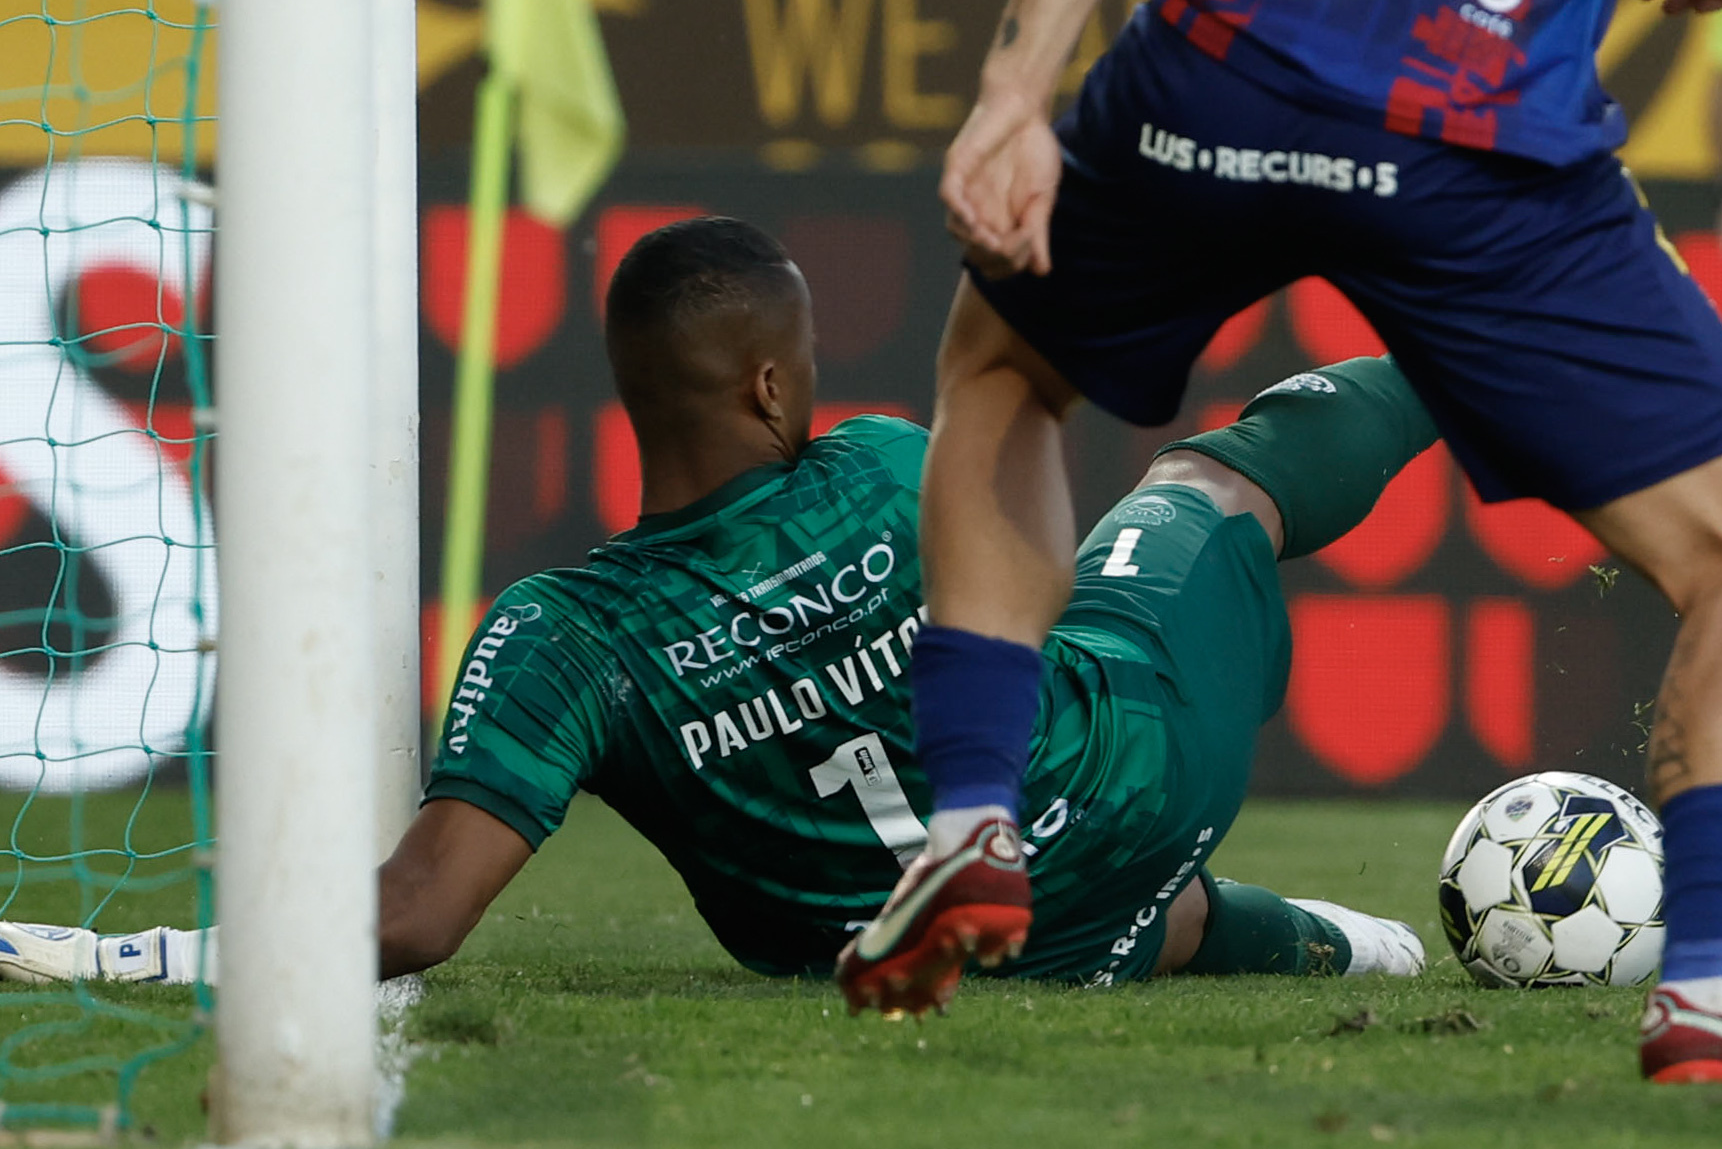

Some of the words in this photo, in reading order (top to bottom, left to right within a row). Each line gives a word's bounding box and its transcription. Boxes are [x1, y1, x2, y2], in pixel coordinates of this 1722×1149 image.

[662, 542, 895, 677] RECONCO
[679, 675, 829, 770] PAULO
[808, 732, 930, 870] 1
